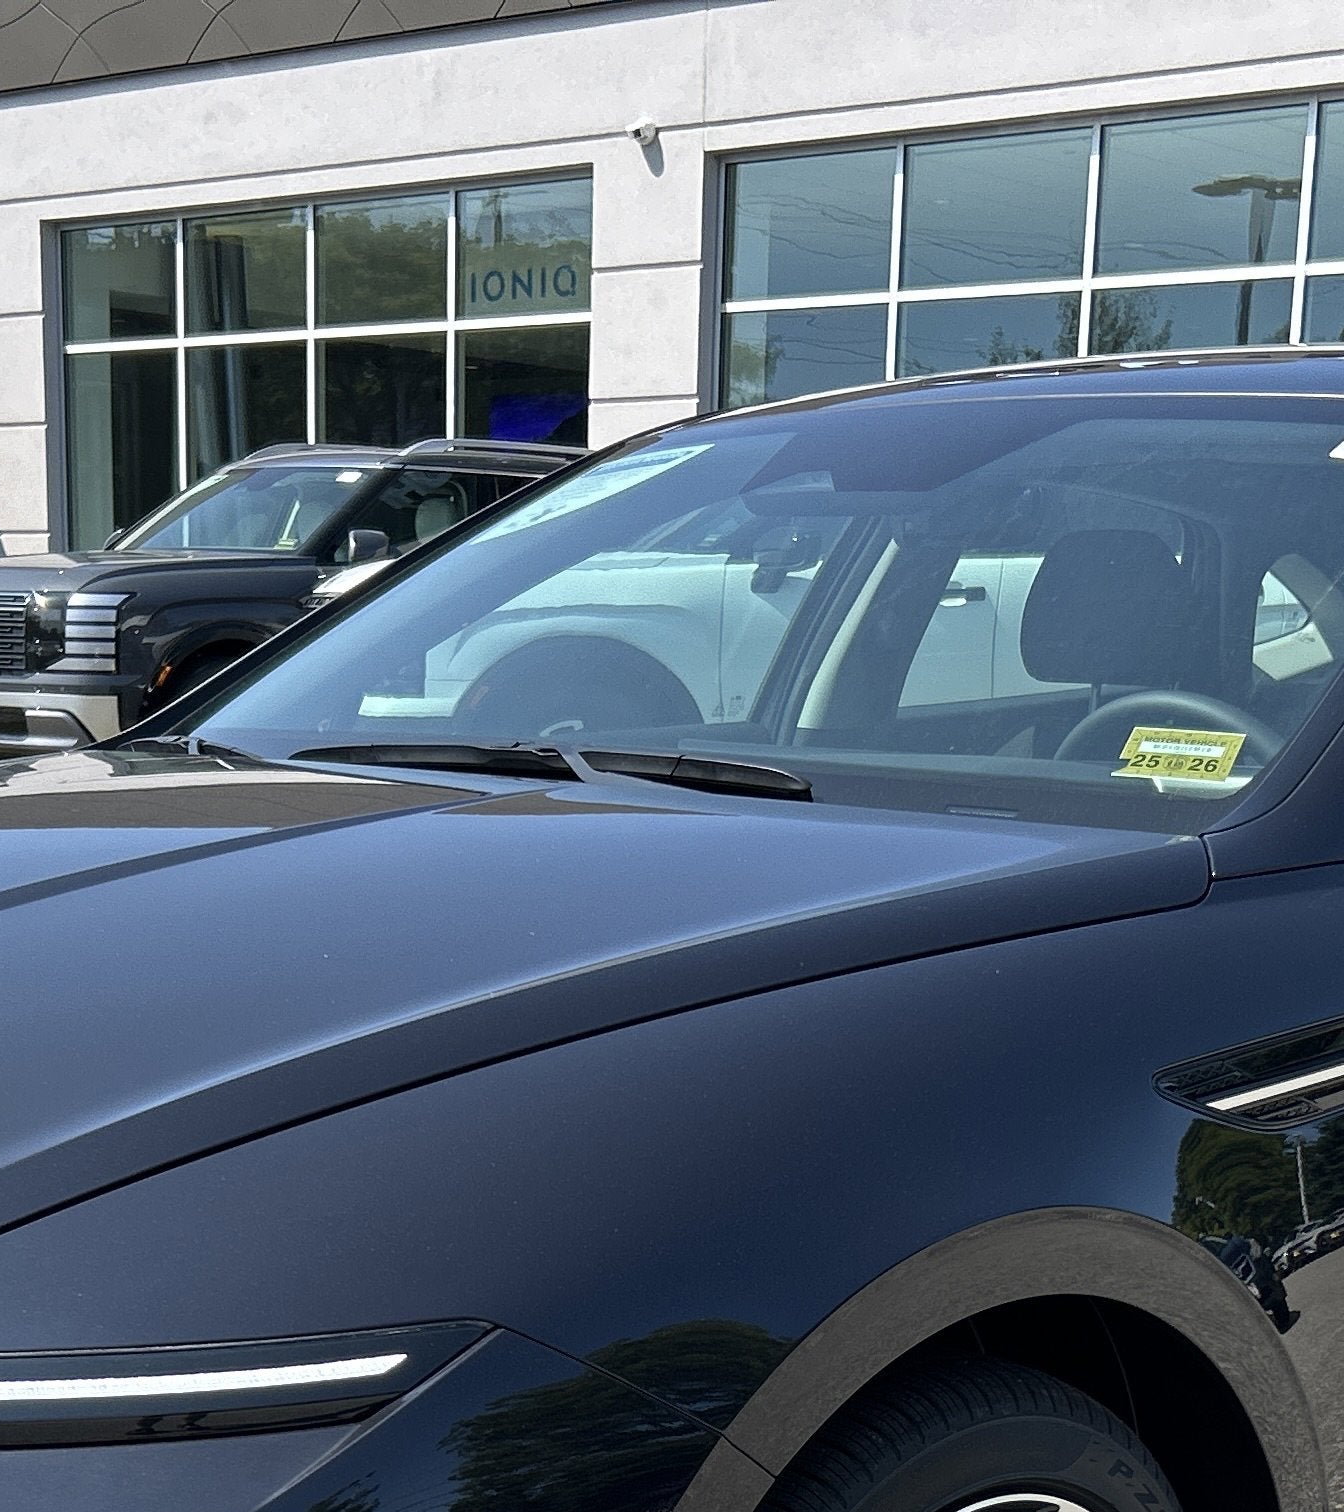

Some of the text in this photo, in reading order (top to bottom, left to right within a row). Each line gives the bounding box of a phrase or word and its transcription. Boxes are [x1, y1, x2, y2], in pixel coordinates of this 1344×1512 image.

[471, 264, 576, 303] IONIQ
[1130, 754, 1219, 773] 25 26
